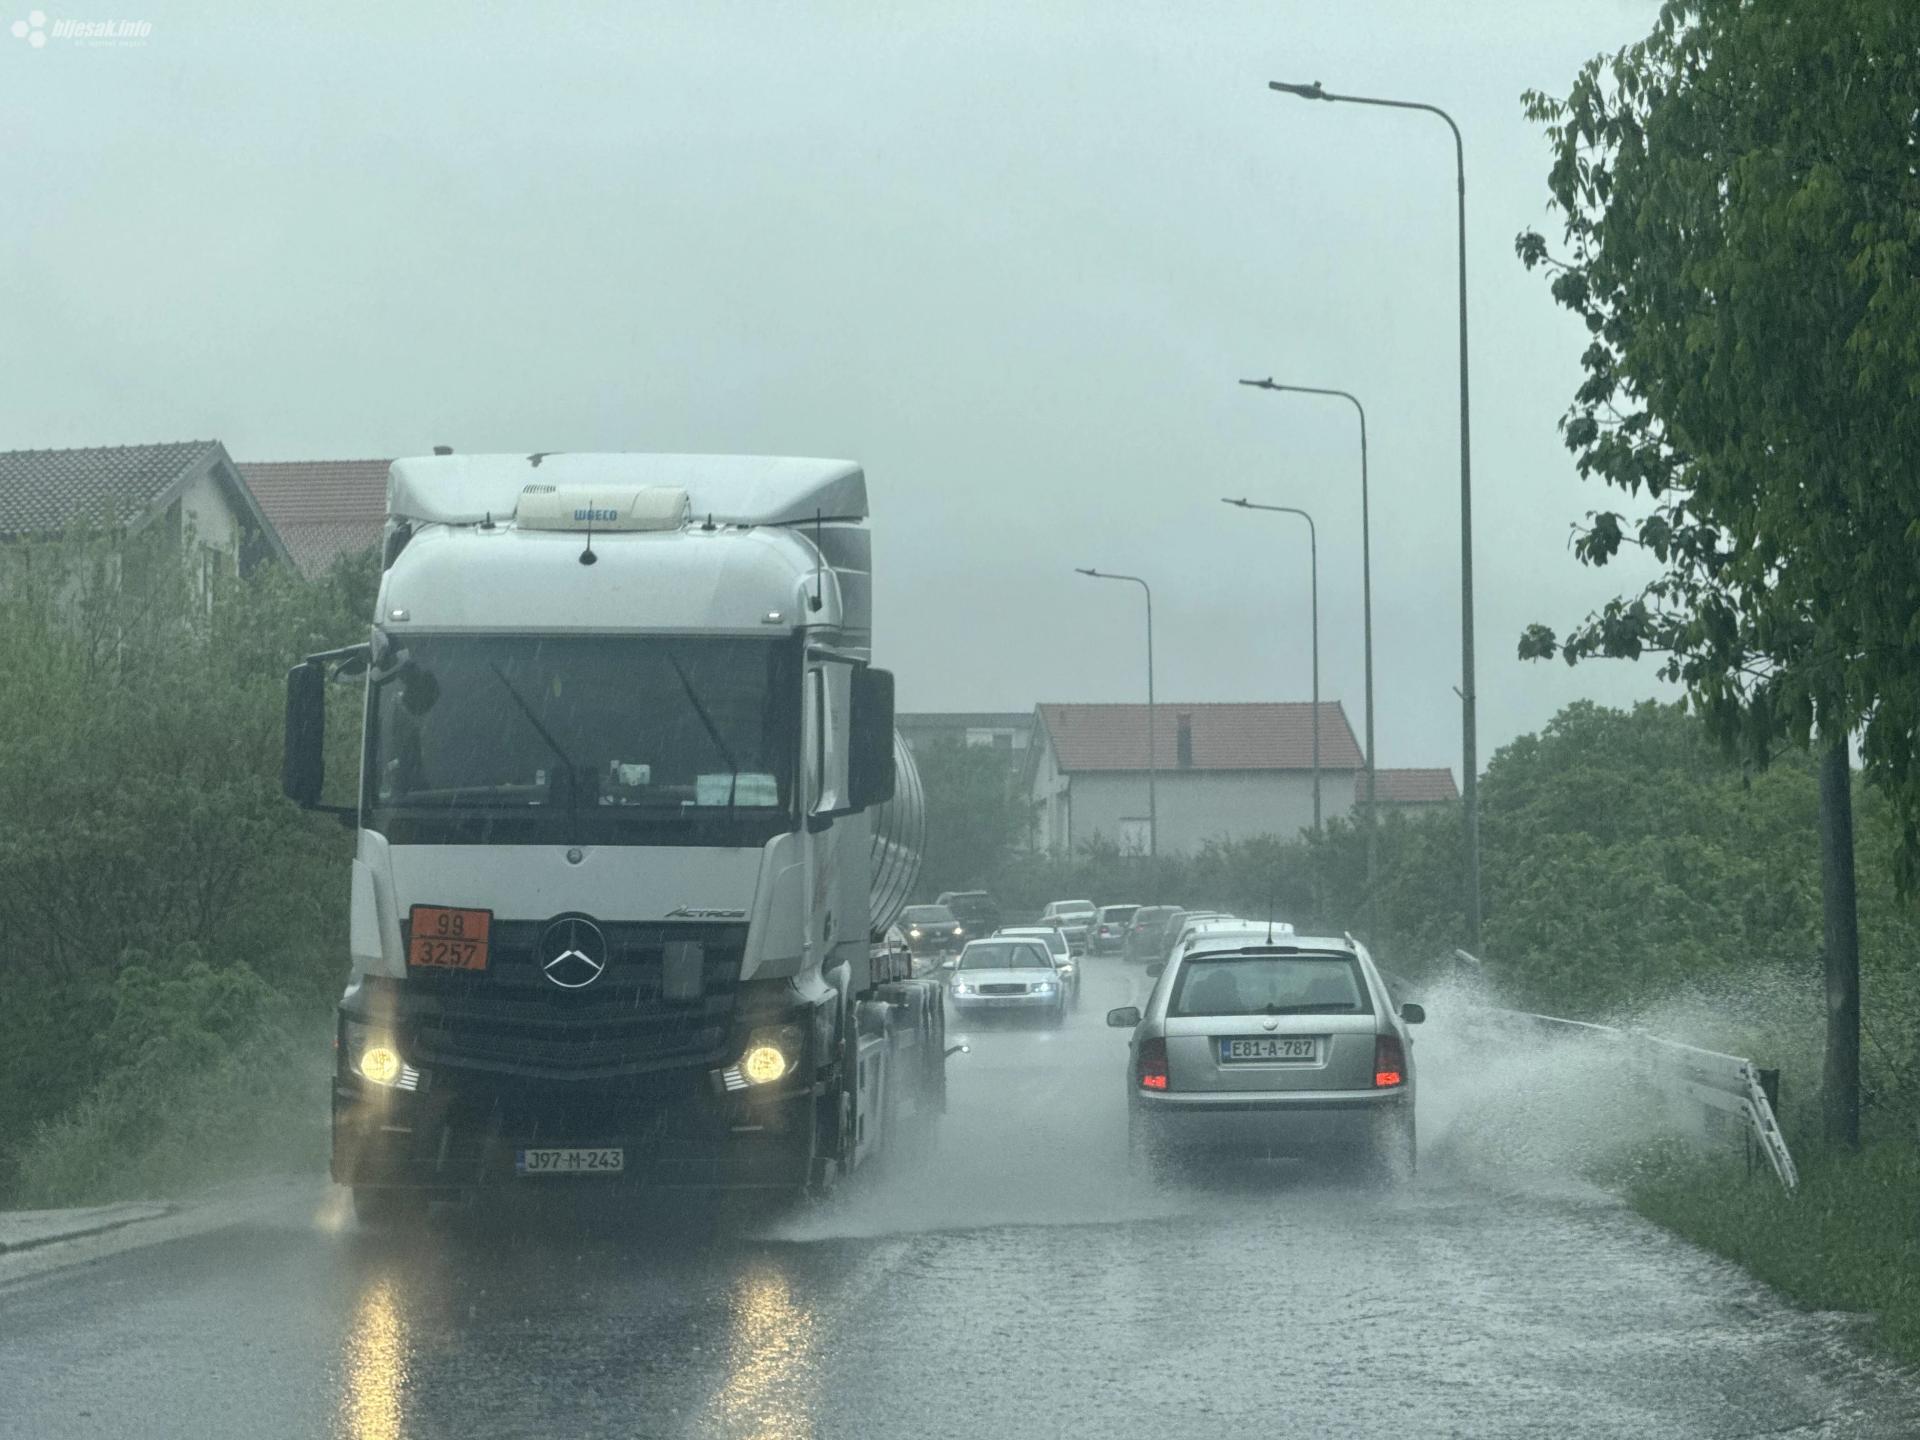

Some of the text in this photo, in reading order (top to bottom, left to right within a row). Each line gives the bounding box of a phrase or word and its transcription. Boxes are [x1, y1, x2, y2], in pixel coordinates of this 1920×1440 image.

[437, 913, 464, 936] 99
[421, 942, 477, 965] 3257
[1232, 1041, 1312, 1056] E81-A-787
[528, 1151, 620, 1169] J97-M-243
